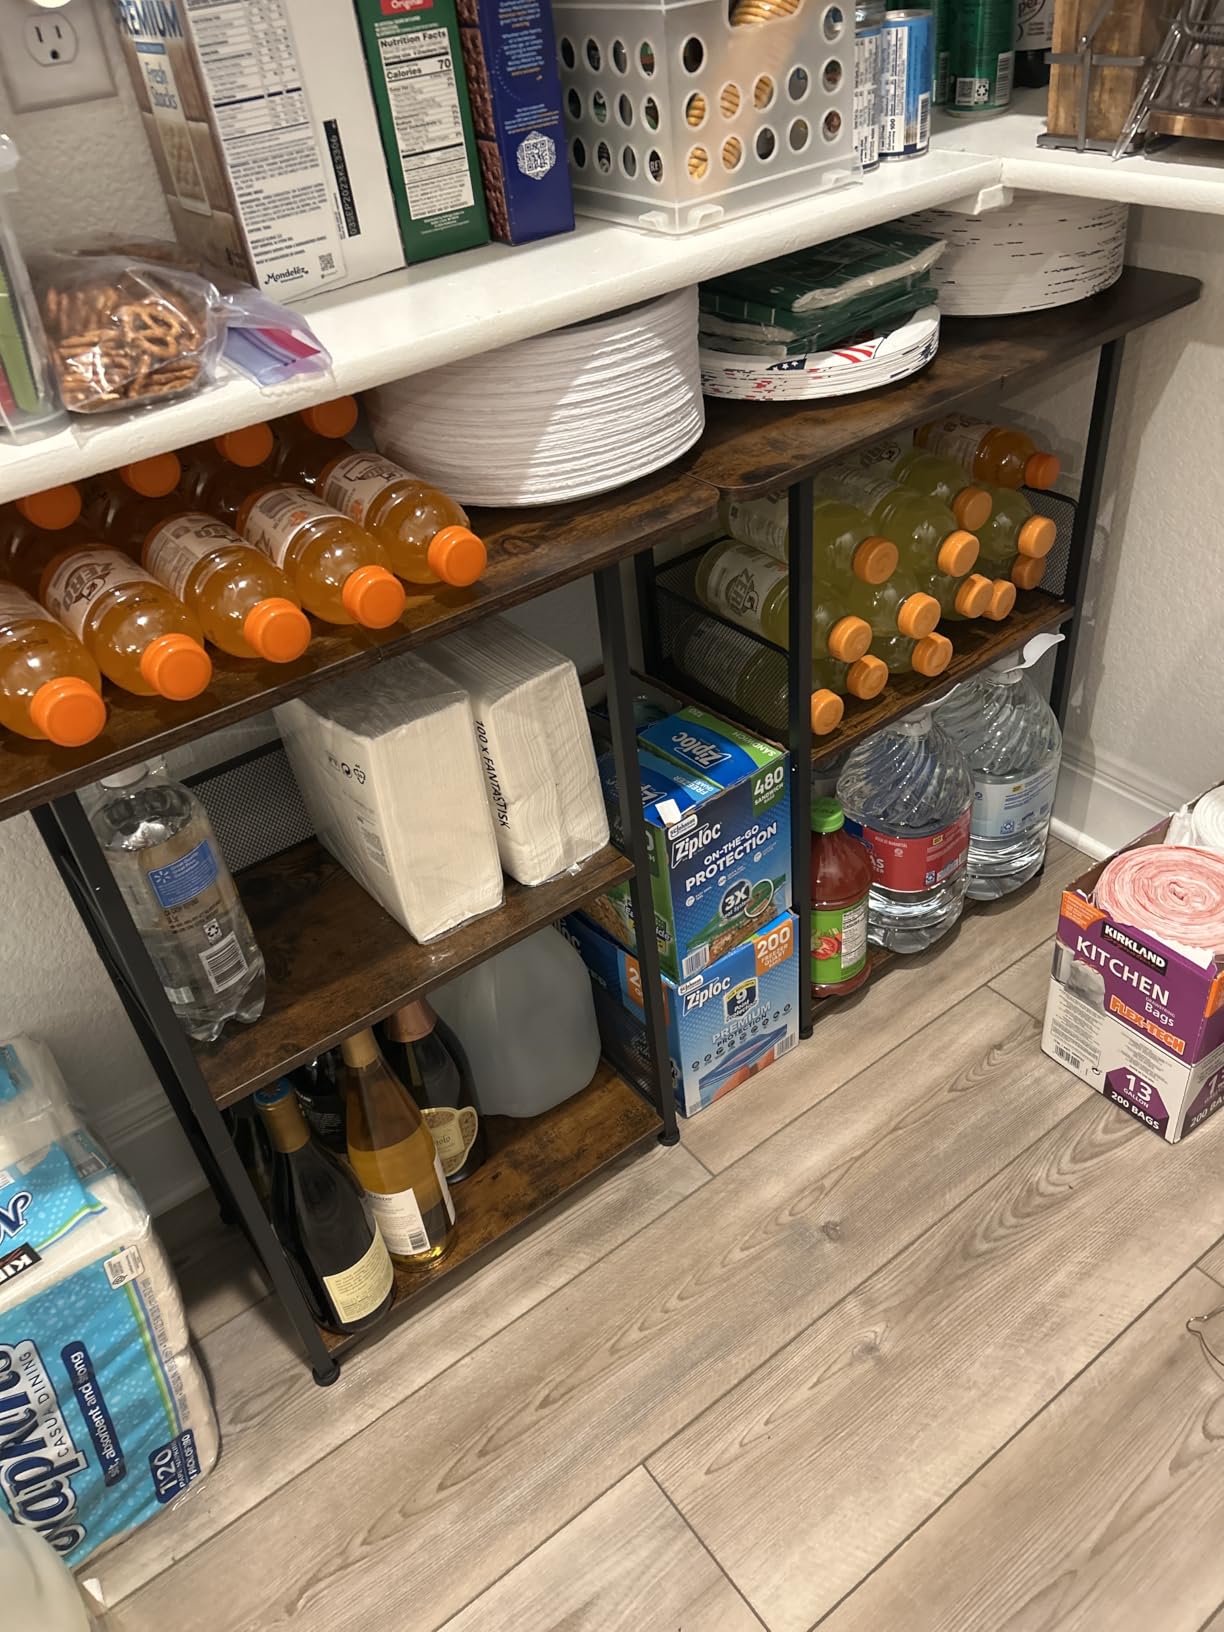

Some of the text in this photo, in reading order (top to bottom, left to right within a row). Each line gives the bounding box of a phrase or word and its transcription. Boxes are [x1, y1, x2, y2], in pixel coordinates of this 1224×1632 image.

[380, 31, 447, 48] Nutrition Facts
[386, 58, 452, 79] Calories 70
[671, 731, 723, 766] Ziploc
[475, 720, 511, 830] 100 x FANTASTISK
[753, 766, 784, 796] 480
[754, 781, 784, 806] SANDWICH
[675, 823, 721, 862] Ziploc
[685, 822, 777, 893] PROTECTION
[703, 824, 760, 866] ON-THE-GO
[724, 881, 748, 912] 3X
[757, 926, 791, 959] 200
[1103, 924, 1167, 968] KIRKLAND
[1076, 935, 1170, 1006] KITCHEN
[686, 976, 731, 1010] Ziploc
[736, 988, 748, 1005] 9
[712, 1001, 771, 1044] PREMIUM
[716, 1011, 768, 1048] PROTECTION
[1108, 994, 1186, 1055] FLEX-TECH
[1144, 1001, 1175, 1027] Bags
[1123, 1086, 1150, 1109] GALLON
[1125, 1073, 1153, 1102] 13
[1111, 1090, 1160, 1131] 200 BAGS
[18, 1351, 50, 1405] DINING
[78, 1384, 97, 1410] and
[88, 1408, 117, 1461] absorbent
